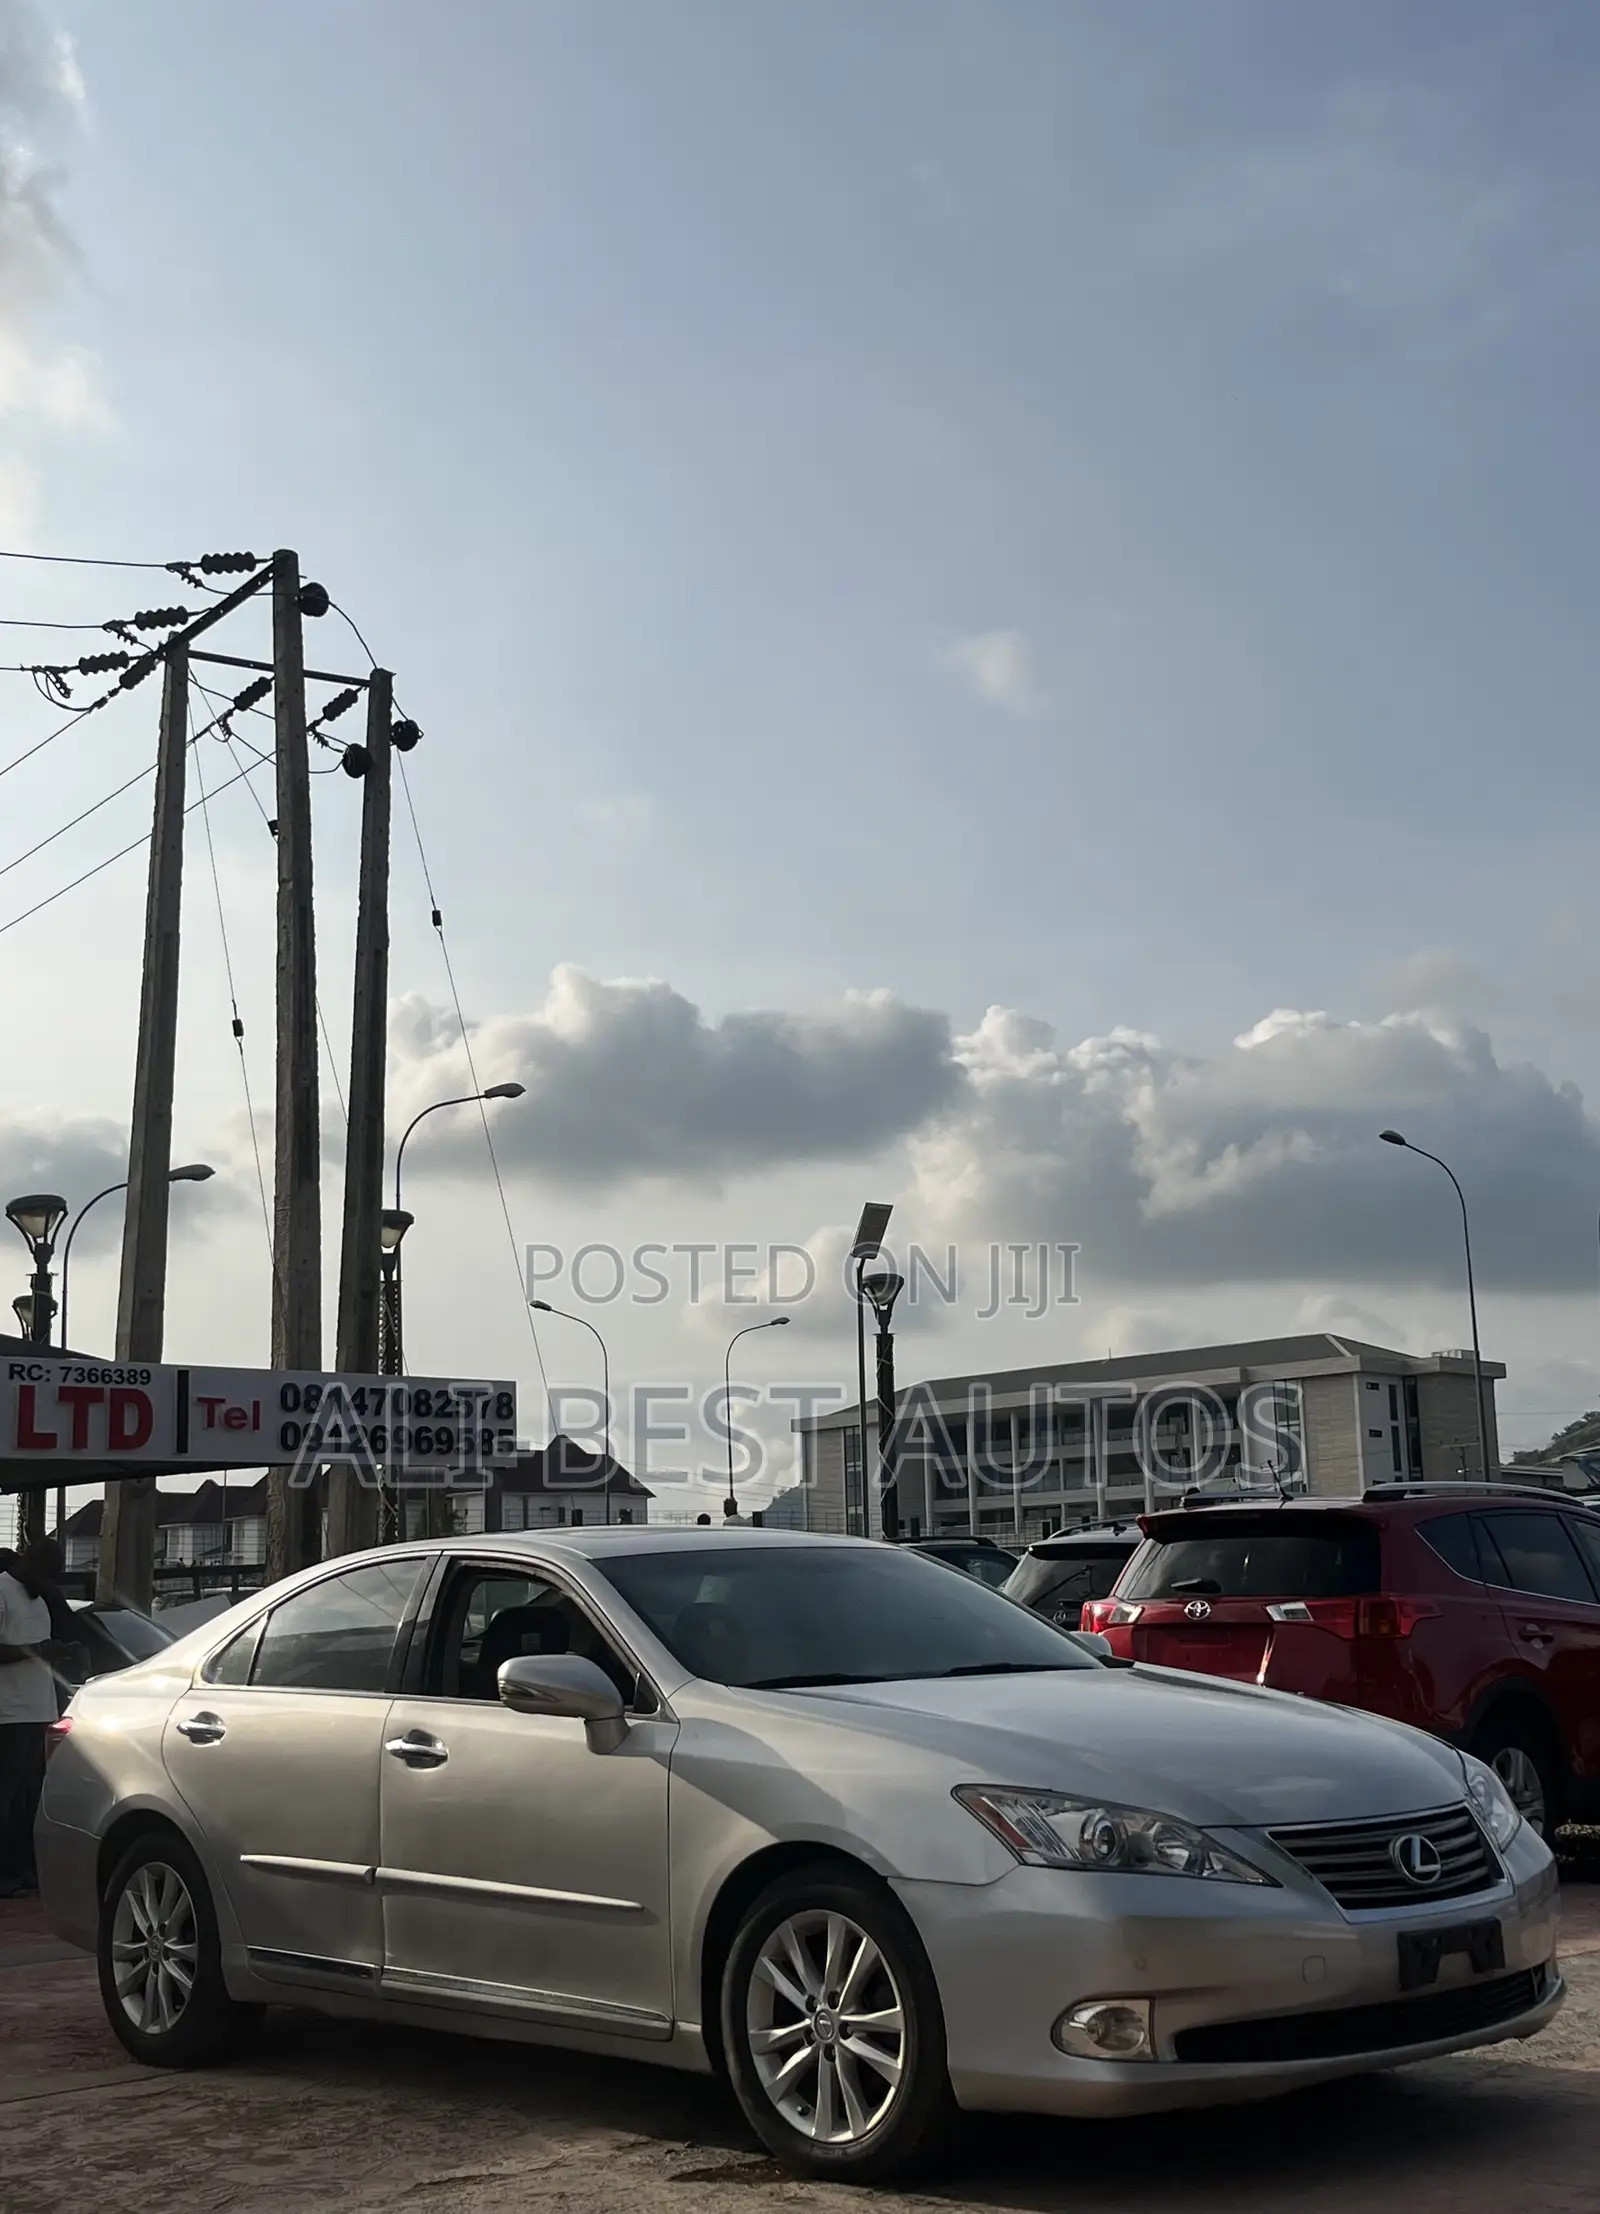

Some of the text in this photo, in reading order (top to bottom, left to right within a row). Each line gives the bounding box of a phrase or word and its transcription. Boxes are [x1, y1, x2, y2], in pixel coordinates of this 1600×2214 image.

[8, 1363, 151, 1386] RC: 7366389
[17, 1384, 154, 1452] LTD
[196, 1396, 260, 1431] Tel
